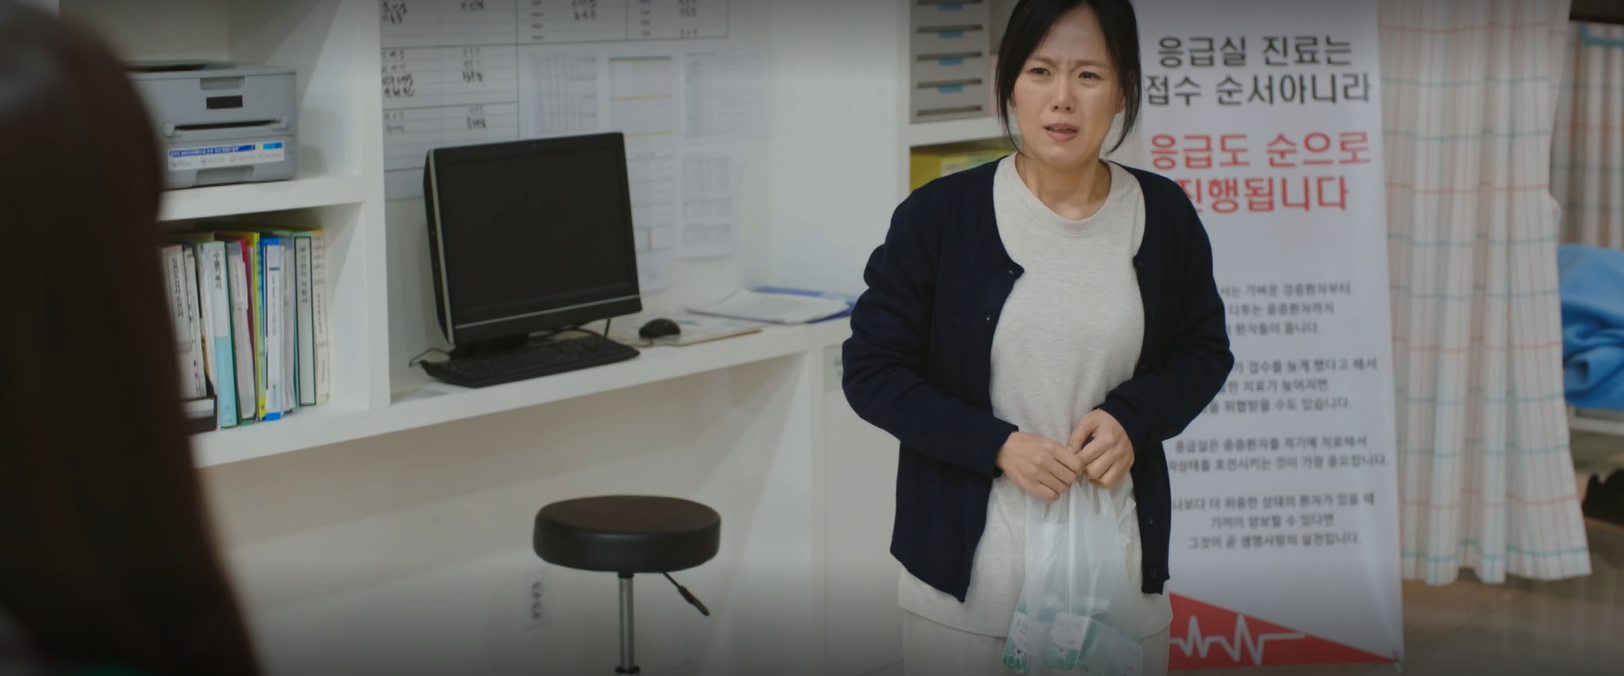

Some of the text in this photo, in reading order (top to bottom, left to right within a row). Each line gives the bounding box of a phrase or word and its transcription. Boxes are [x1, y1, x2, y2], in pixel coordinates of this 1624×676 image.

[1158, 36, 1353, 69] 응급실 진료는
[1145, 72, 1372, 106] 접수 순서아니라
[1150, 132, 1371, 171] 응급도 순으로
[1175, 176, 1349, 215] 진행됩니다
[1248, 359, 1283, 375] 접수를
[1287, 359, 1310, 374] 늦게
[1314, 358, 1349, 372] 했다고
[1352, 357, 1378, 371] 해서
[1243, 379, 1278, 393] 치료가
[1281, 377, 1329, 392] 늦어지면
[1275, 399, 1298, 411] 수도
[1276, 455, 1298, 470] 것이
[1301, 454, 1324, 469] 가장
[1286, 514, 1297, 528] 수
[1300, 513, 1335, 527] 있다면
